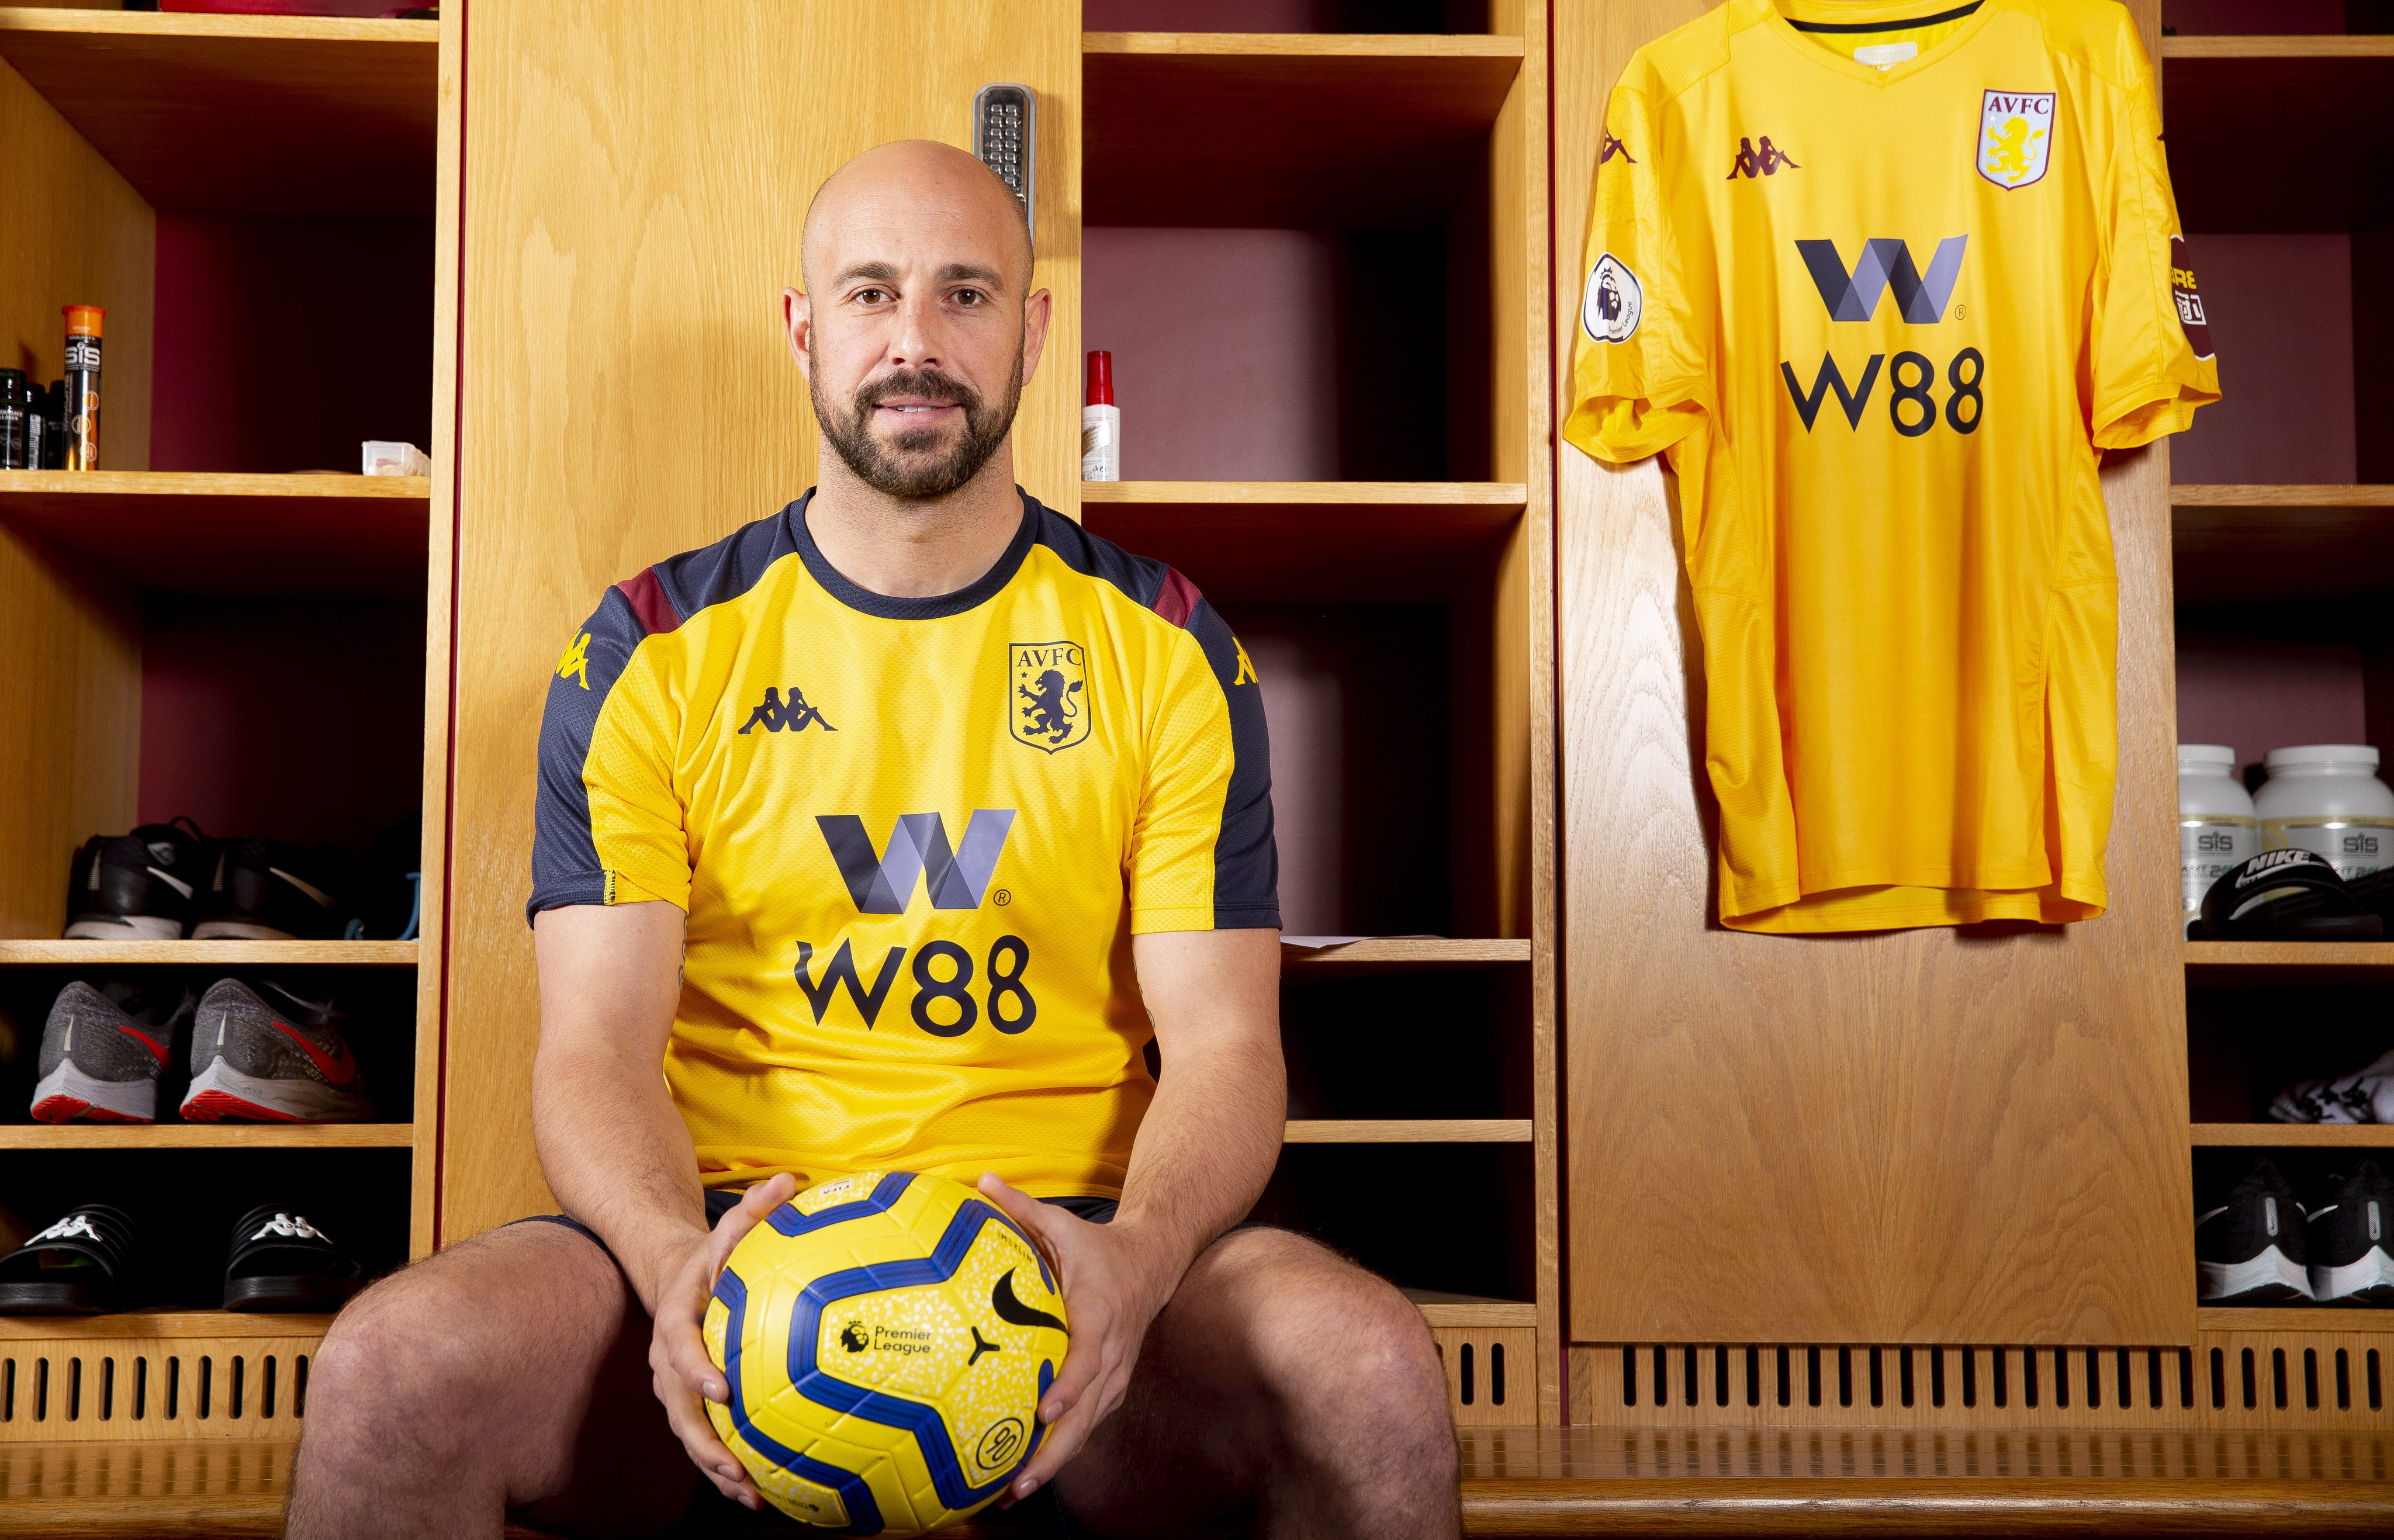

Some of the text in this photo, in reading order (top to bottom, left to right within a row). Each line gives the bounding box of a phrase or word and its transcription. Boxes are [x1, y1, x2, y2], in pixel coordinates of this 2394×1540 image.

[1988, 96, 2049, 115] AVFC
[1608, 301, 1634, 335] Premier League
[1780, 347, 1985, 438] W88
[1017, 648, 1082, 668] AVFC
[2246, 849, 2311, 875] NIKE
[794, 935, 1037, 1038] W88
[876, 1326, 932, 1340] Premier
[874, 1338, 930, 1355] League
